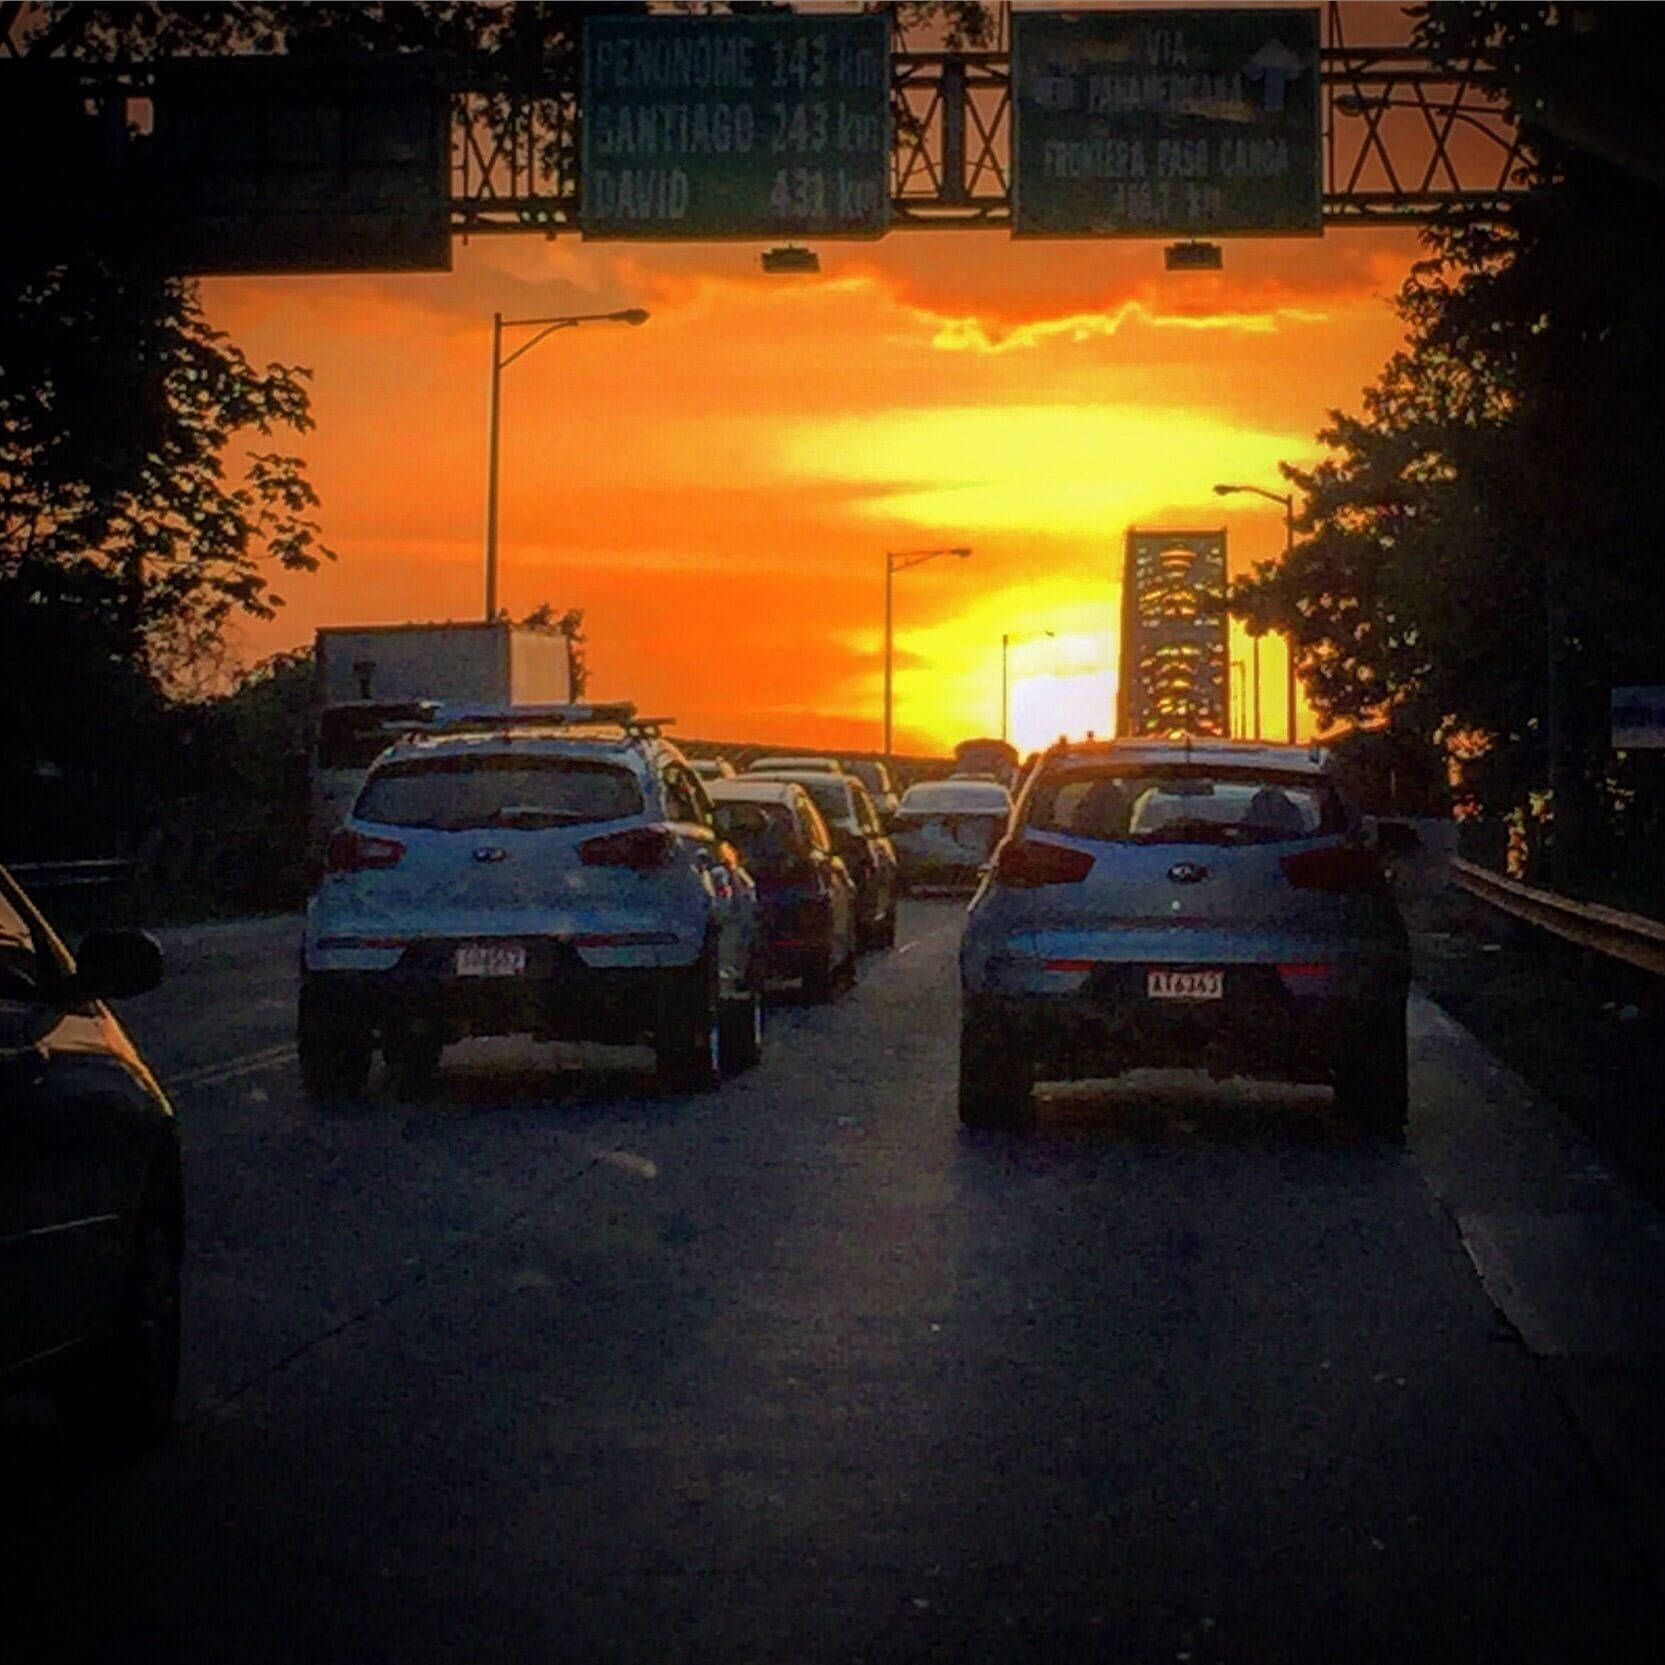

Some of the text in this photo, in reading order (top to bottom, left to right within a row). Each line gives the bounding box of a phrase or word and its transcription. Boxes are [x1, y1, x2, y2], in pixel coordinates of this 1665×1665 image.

[596, 35, 754, 89] PENONOME
[771, 34, 829, 88] 143
[595, 101, 754, 155] SANTIAGO
[771, 101, 829, 155] 243
[595, 168, 689, 220] DAVID
[769, 167, 827, 219] 431
